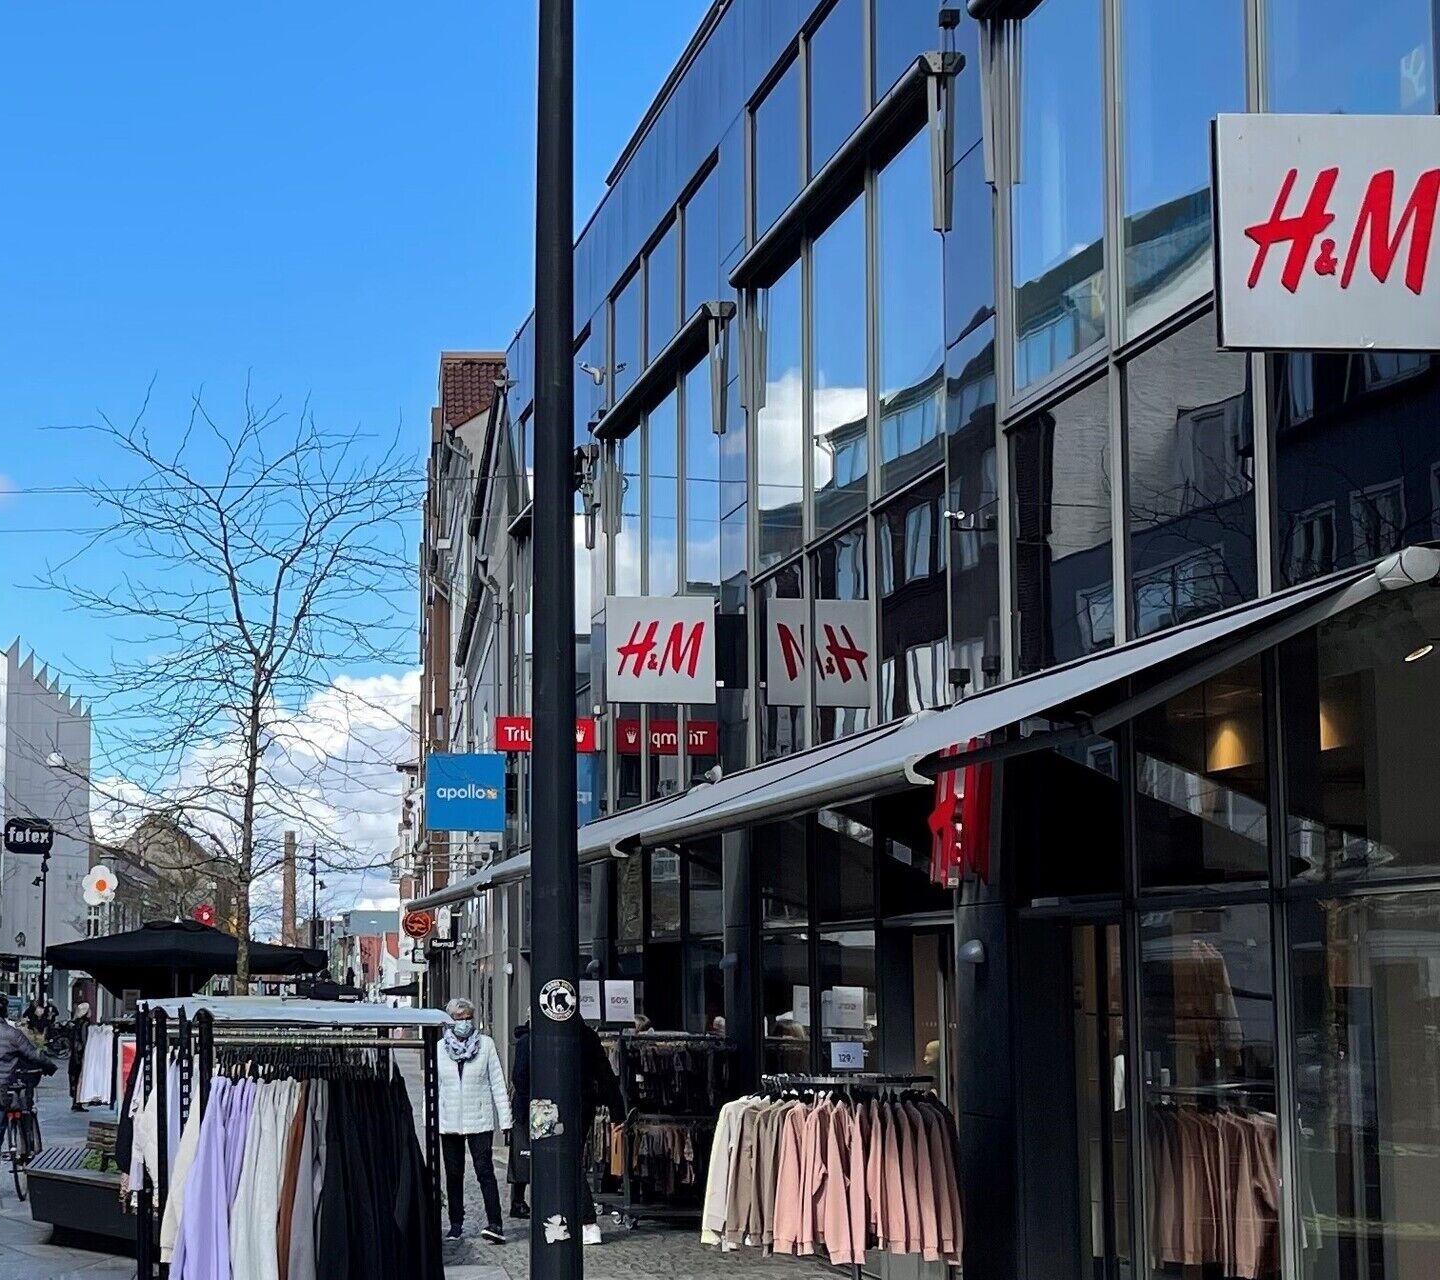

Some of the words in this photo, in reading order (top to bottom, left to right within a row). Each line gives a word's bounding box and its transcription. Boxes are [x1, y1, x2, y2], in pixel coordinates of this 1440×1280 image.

[1244, 167, 1440, 295] H&M
[617, 620, 705, 679] H&M
[503, 725, 533, 742] Triu
[436, 785, 486, 802] apollo
